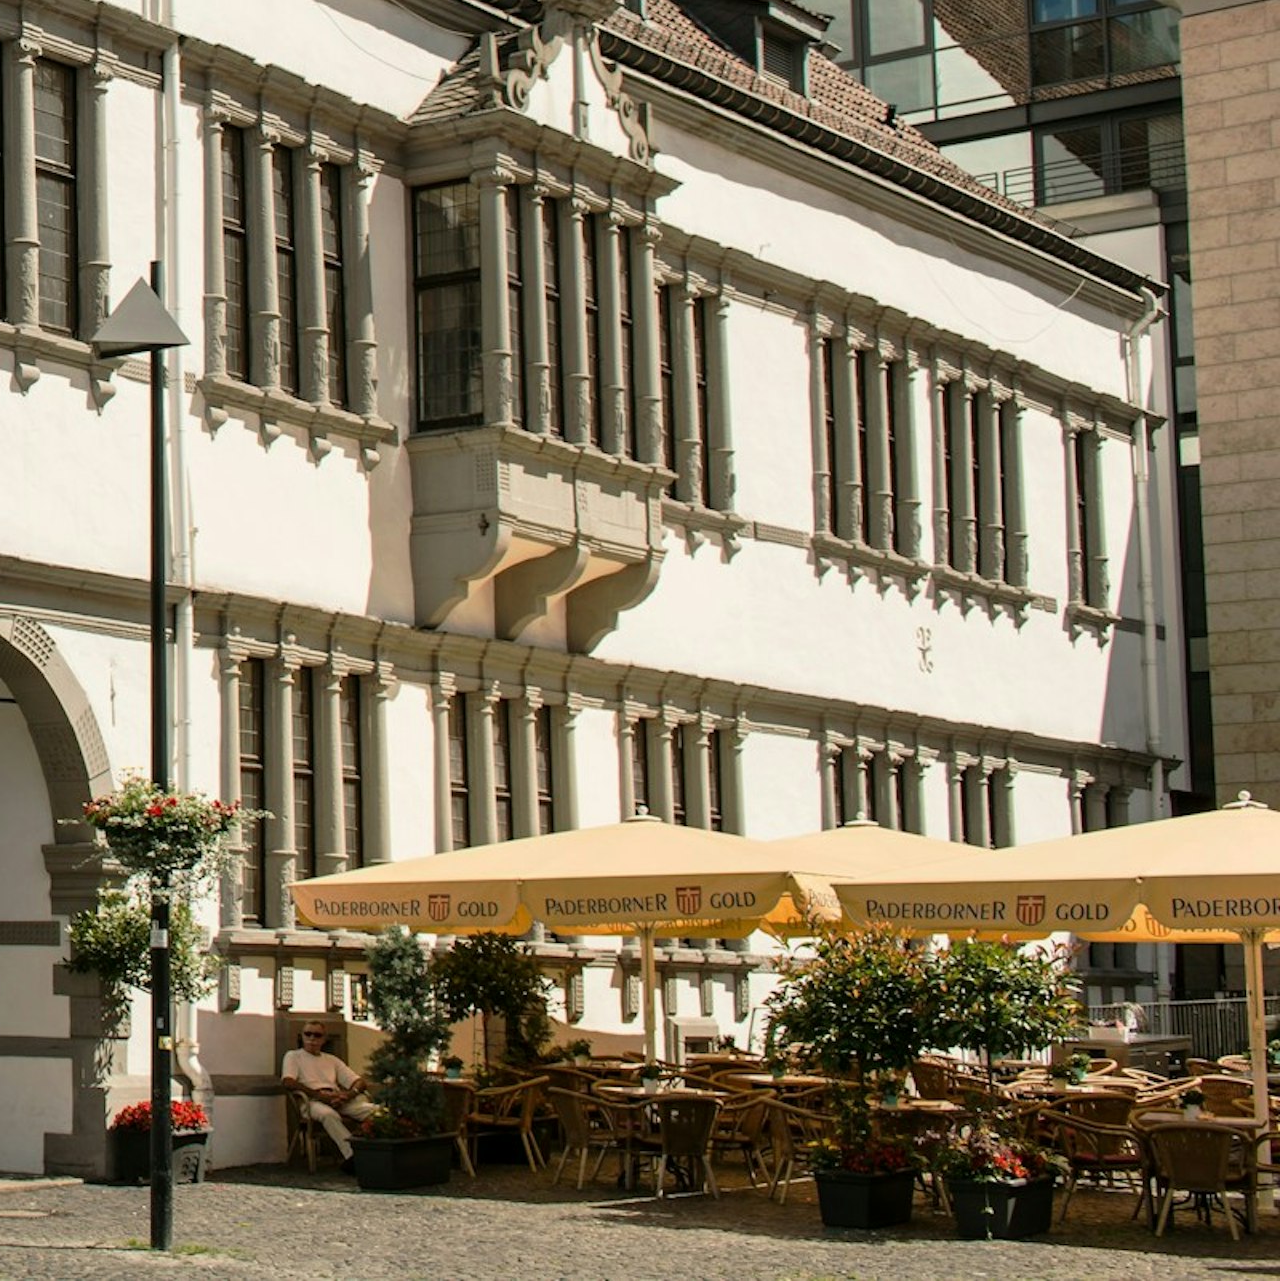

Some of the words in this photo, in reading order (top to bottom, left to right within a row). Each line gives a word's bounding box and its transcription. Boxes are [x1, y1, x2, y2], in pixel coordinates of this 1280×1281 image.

[314, 898, 421, 917] PADERBORNER
[457, 901, 499, 917] GOLD
[545, 893, 667, 916] PADERBORNER
[710, 891, 756, 909] GOLD
[866, 899, 1006, 920] PADERBORNER
[1056, 902, 1109, 921] GOLD
